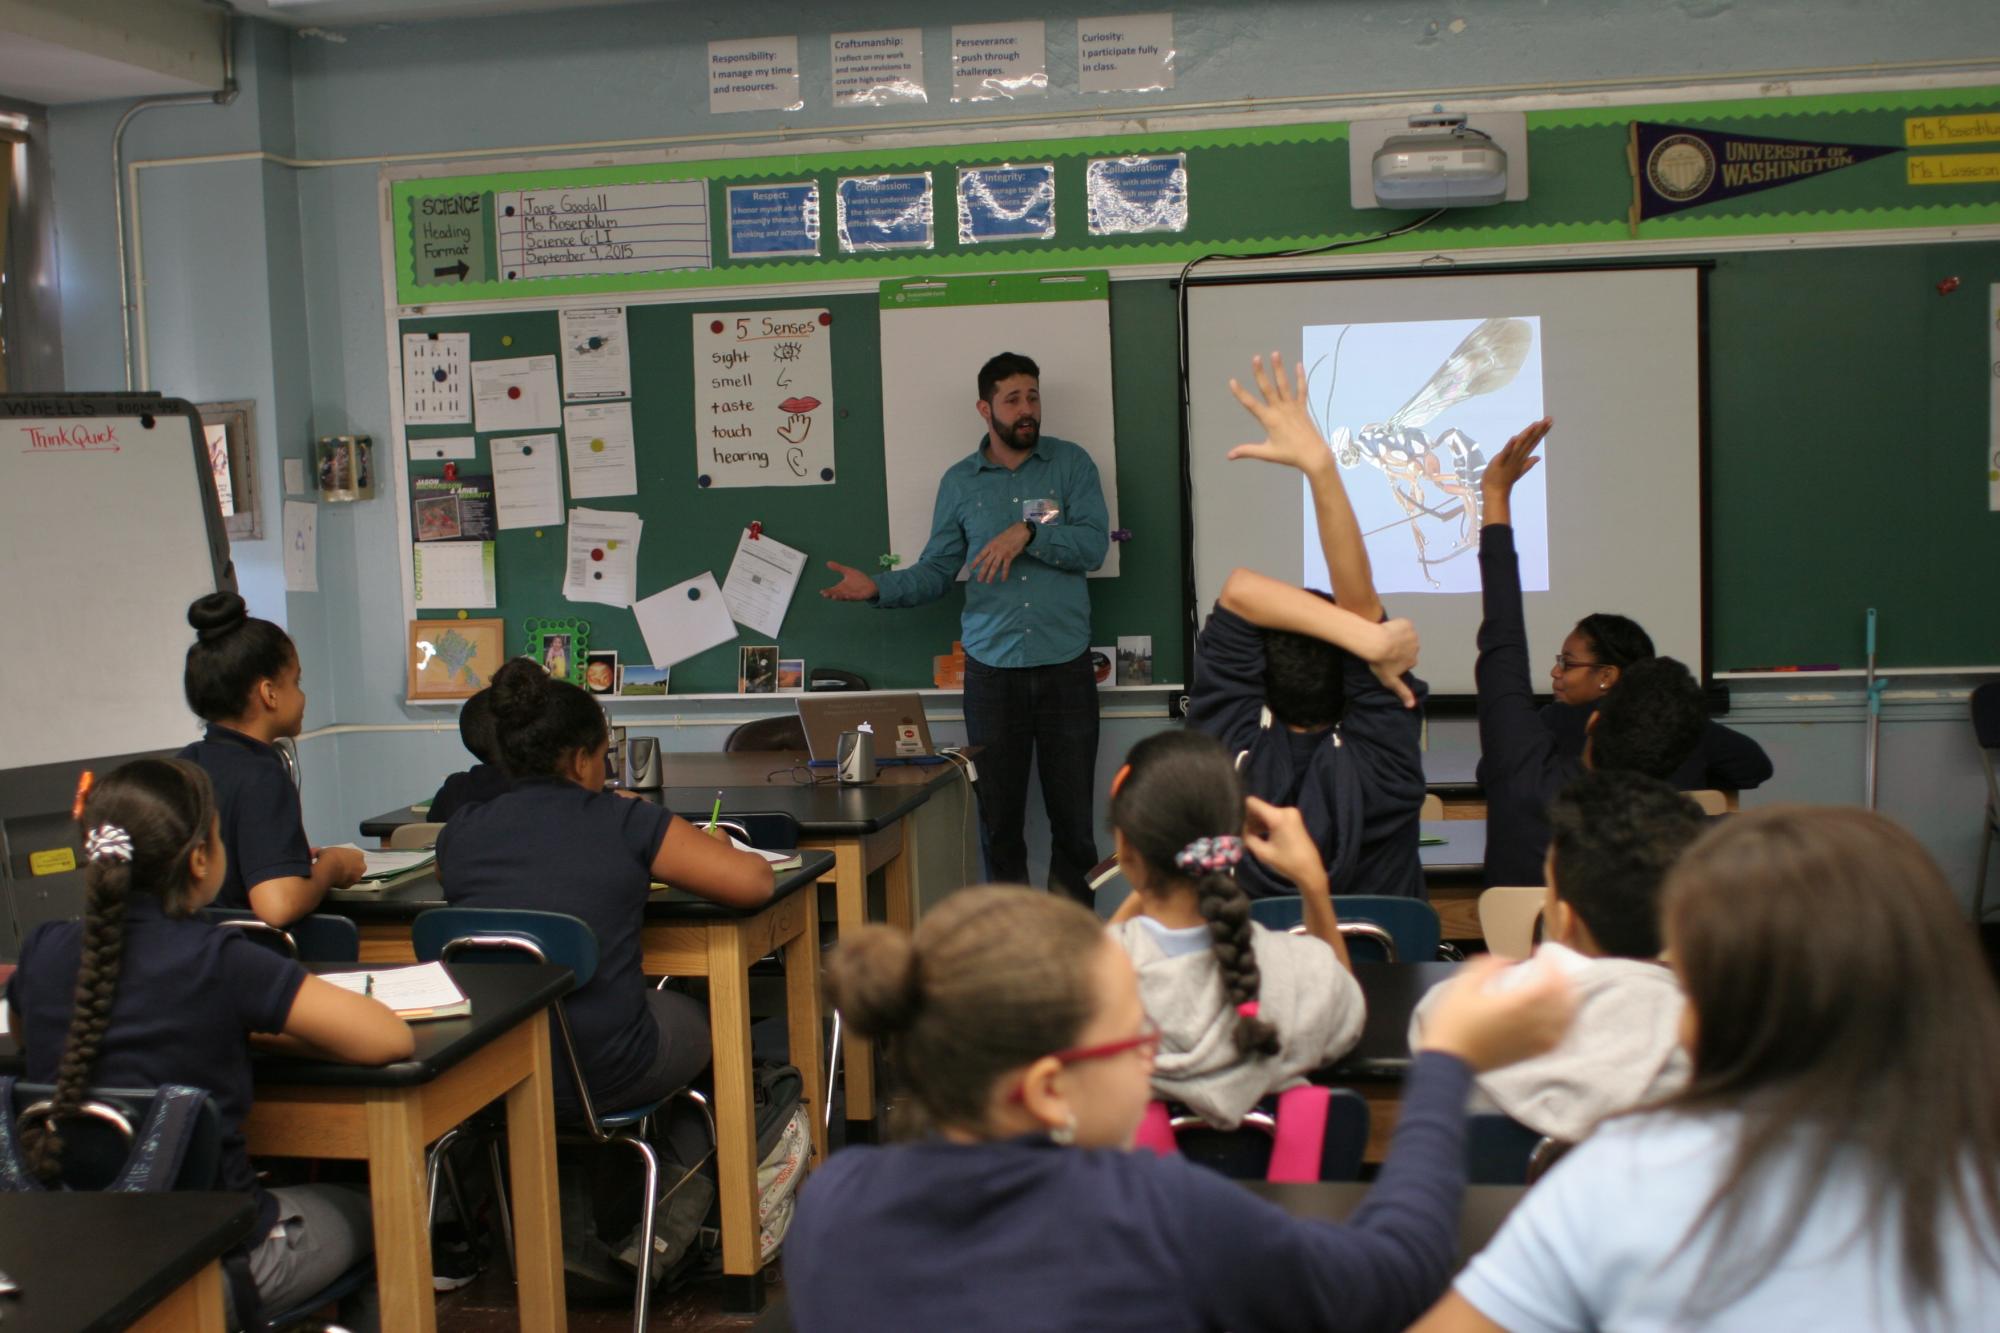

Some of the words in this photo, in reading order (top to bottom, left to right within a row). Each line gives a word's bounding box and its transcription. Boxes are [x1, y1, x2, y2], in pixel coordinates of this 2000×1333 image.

[834, 37, 903, 49] Craftsmanship:
[956, 37, 1018, 47] Perseverance:
[1082, 32, 1124, 42] Curiosity:
[712, 52, 777, 64] Responsibility:
[874, 53, 884, 61] my
[961, 53, 982, 63] push
[984, 51, 1020, 62] through
[1088, 46, 1136, 58] participate
[1138, 45, 1158, 55] fully
[718, 70, 752, 79] manage
[755, 69, 769, 77] my
[771, 66, 792, 75] time
[850, 65, 869, 73] make
[956, 67, 1005, 77] challenges.
[1082, 63, 1091, 72] in
[1093, 62, 1117, 71] class.
[713, 85, 729, 94] and
[732, 83, 778, 92] resources.
[1726, 141, 1823, 161] UNIVERSITY
[1828, 147, 1849, 157] OF
[985, 173, 1025, 183] Integrity:
[1722, 155, 1853, 188] WASHINGTON
[855, 182, 911, 192] Compassion:
[753, 191, 789, 200] Respect:
[422, 195, 480, 215] SCIENCE
[524, 198, 554, 215] Jane
[560, 194, 607, 212] Goodall
[549, 214, 618, 230] Rosenblum
[423, 222, 470, 243] Heading
[526, 232, 575, 248] Science
[424, 243, 469, 258] Format
[526, 248, 585, 266] September
[605, 243, 634, 259] 2015
[736, 318, 751, 340] 5
[762, 317, 815, 336] Senses
[712, 349, 750, 369] sight
[712, 373, 752, 389] smell
[711, 399, 755, 415] taste
[712, 424, 752, 438] touch
[713, 447, 770, 469] hearing
